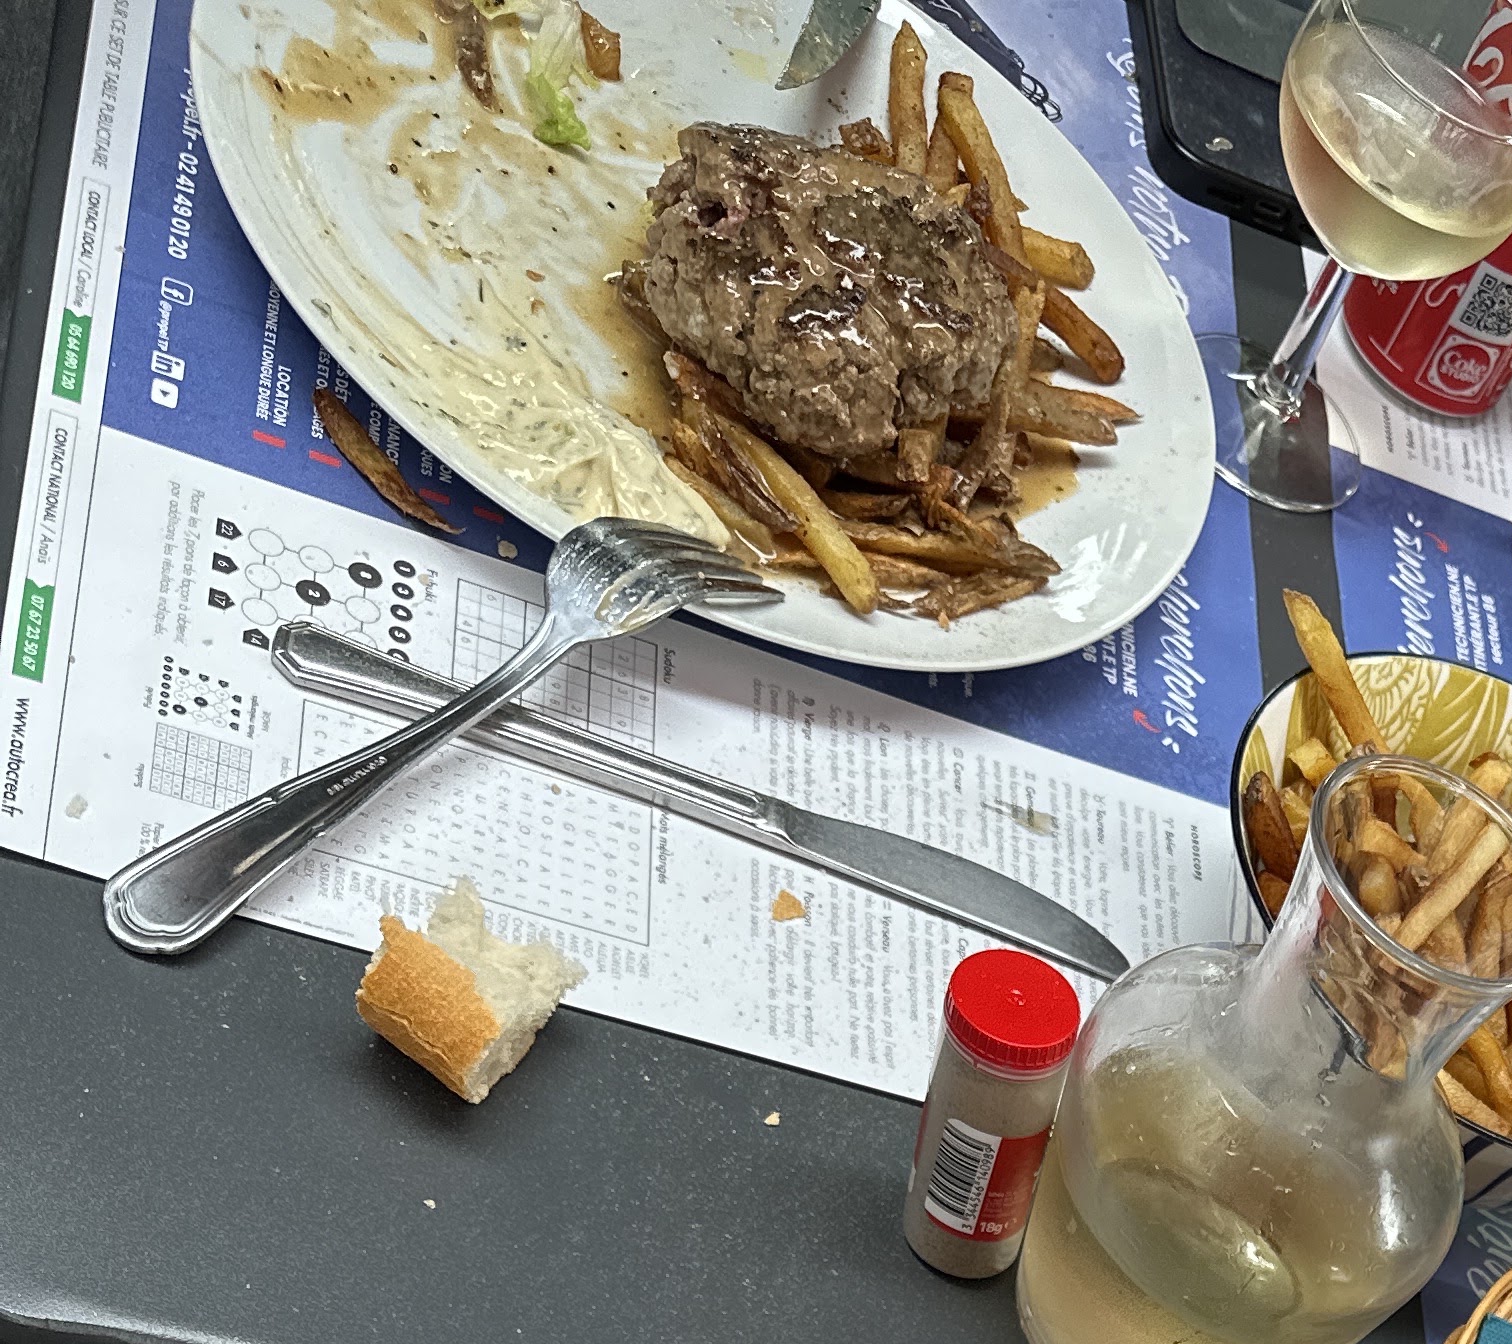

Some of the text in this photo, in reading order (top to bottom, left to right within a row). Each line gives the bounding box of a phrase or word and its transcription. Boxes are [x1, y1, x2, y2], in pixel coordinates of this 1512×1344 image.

[177, 152, 198, 172] 02
[175, 174, 196, 193] 41
[84, 190, 101, 231] CONTACT
[172, 193, 194, 216] 49
[169, 217, 190, 236] 01
[79, 230, 96, 259] LOCAL
[166, 235, 188, 259] 20
[72, 268, 90, 309] Caroline
[263, 331, 276, 345] ET
[260, 344, 274, 387] LONGUE
[1441, 353, 1489, 376] Coke
[256, 386, 271, 421] DURÉE
[273, 365, 290, 427] LOCATION
[48, 427, 68, 474] CONTACT
[42, 473, 61, 523] NATIONAL
[1463, 574, 1479, 592] TP
[1444, 561, 1469, 661] TECHNICIEN.NE
[1481, 593, 1495, 612] 86
[20, 594, 45, 671] 07 67 23 50 67
[661, 647, 676, 685] Sudoku
[1101, 664, 1116, 685] TP
[1, 697, 31, 816] www.autocrea.fr
